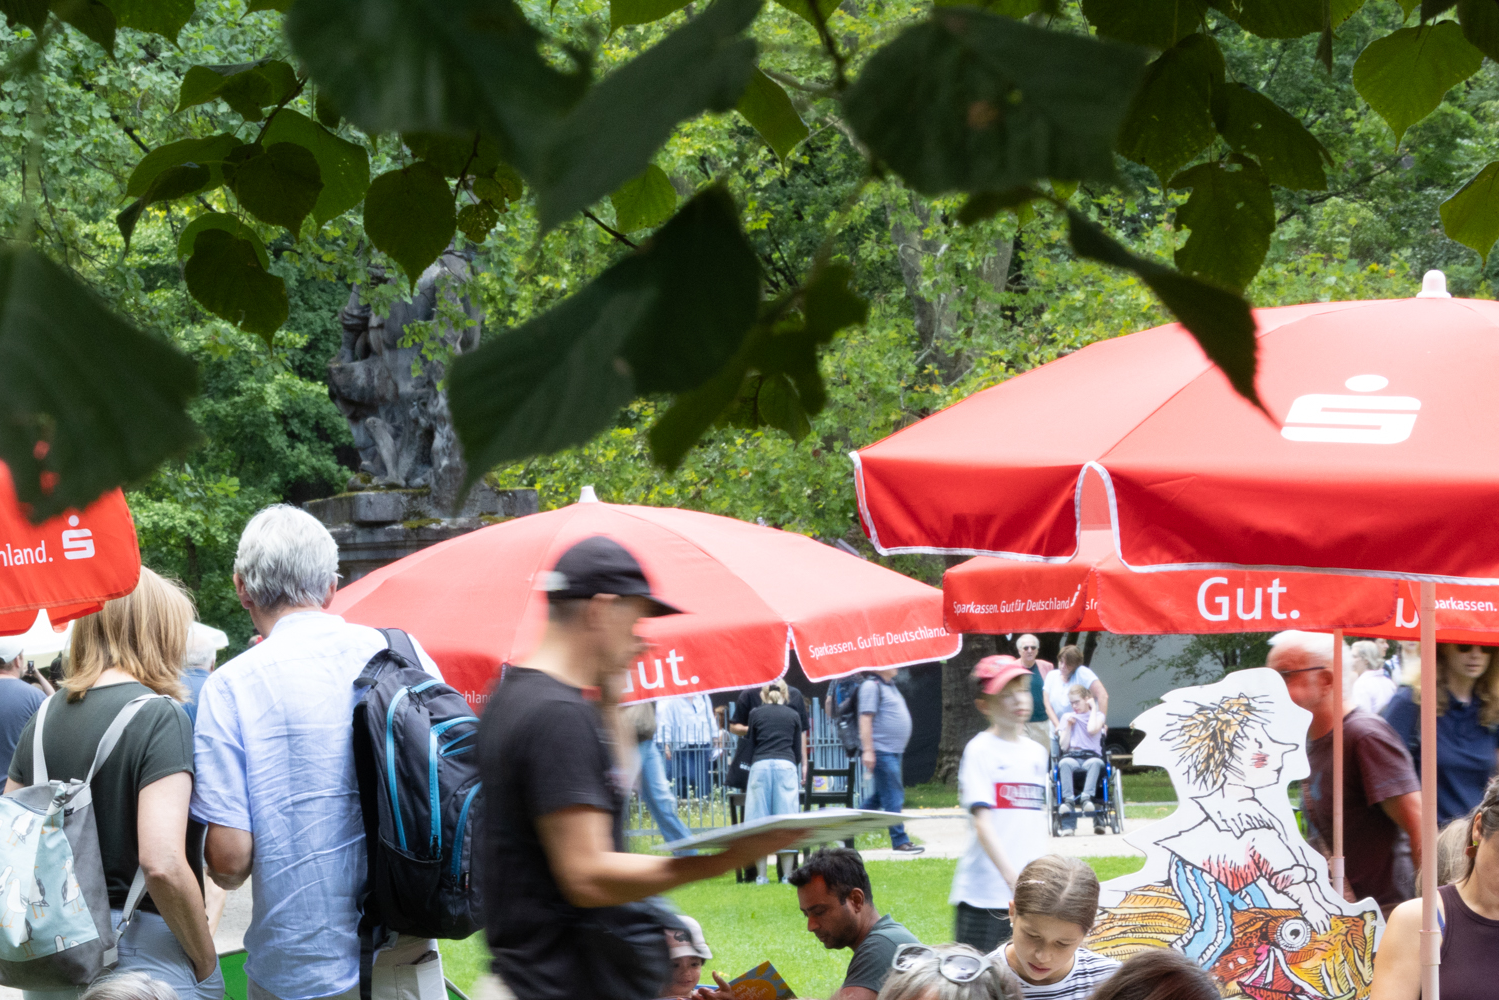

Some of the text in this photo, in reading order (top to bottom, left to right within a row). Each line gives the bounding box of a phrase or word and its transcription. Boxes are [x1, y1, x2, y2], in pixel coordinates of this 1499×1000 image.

[953, 601, 999, 616] Sparkassen.
[1000, 600, 1015, 613] Gut
[1196, 576, 1301, 622] Gut.
[1435, 596, 1498, 612] arkassen.
[808, 641, 857, 660] Sparkassen.
[857, 636, 873, 650] Gu
[621, 648, 700, 693] ut.
